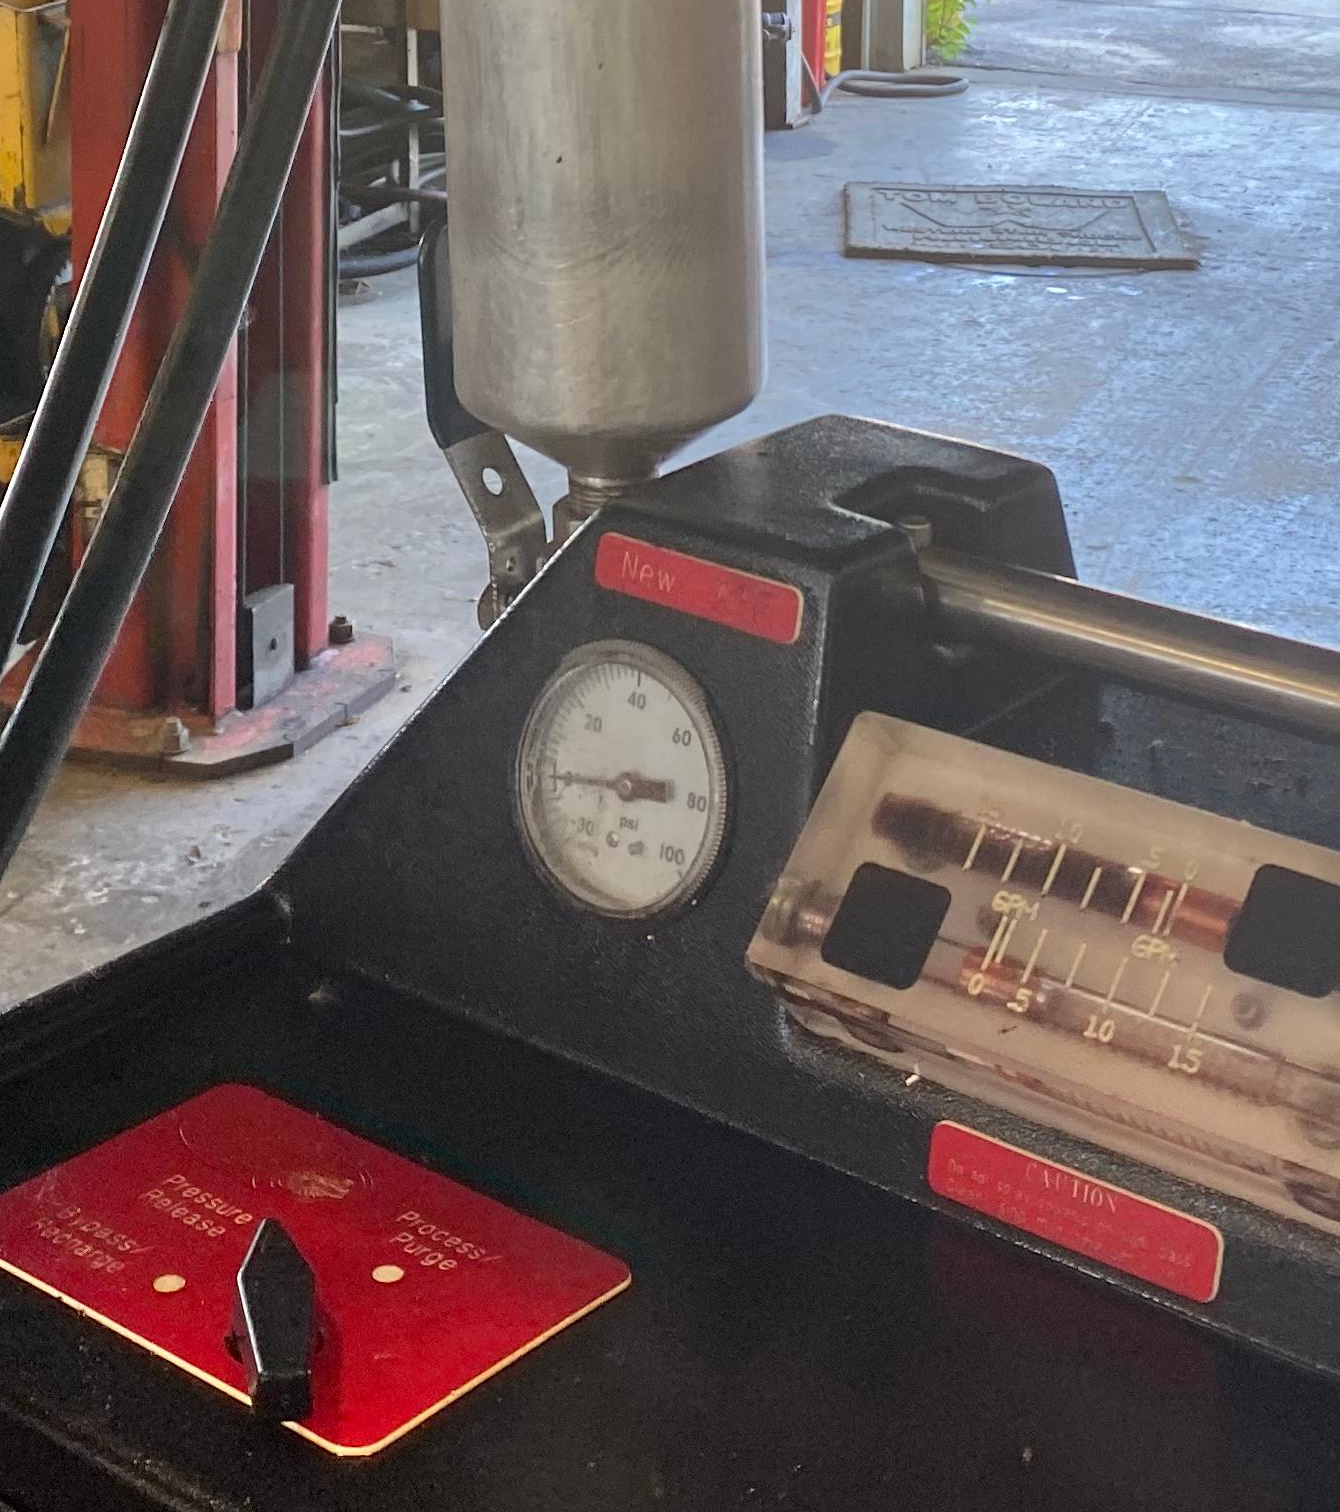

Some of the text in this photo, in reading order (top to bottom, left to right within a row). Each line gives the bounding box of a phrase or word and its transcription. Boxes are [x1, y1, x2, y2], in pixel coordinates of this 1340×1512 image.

[876, 190, 957, 206] TOM
[621, 550, 676, 594] New
[626, 691, 647, 711] 40
[583, 713, 603, 734] 20
[671, 727, 692, 747] 60
[686, 792, 708, 813] 80
[619, 815, 639, 833] psi
[658, 841, 685, 866] 100
[991, 890, 1040, 921] GPM
[968, 973, 985, 995] 0
[1083, 1014, 1116, 1043] 10
[1167, 1044, 1203, 1074] 15
[163, 1173, 254, 1226] Pressure
[137, 1188, 227, 1238] Release
[388, 1231, 459, 1271] Purge
